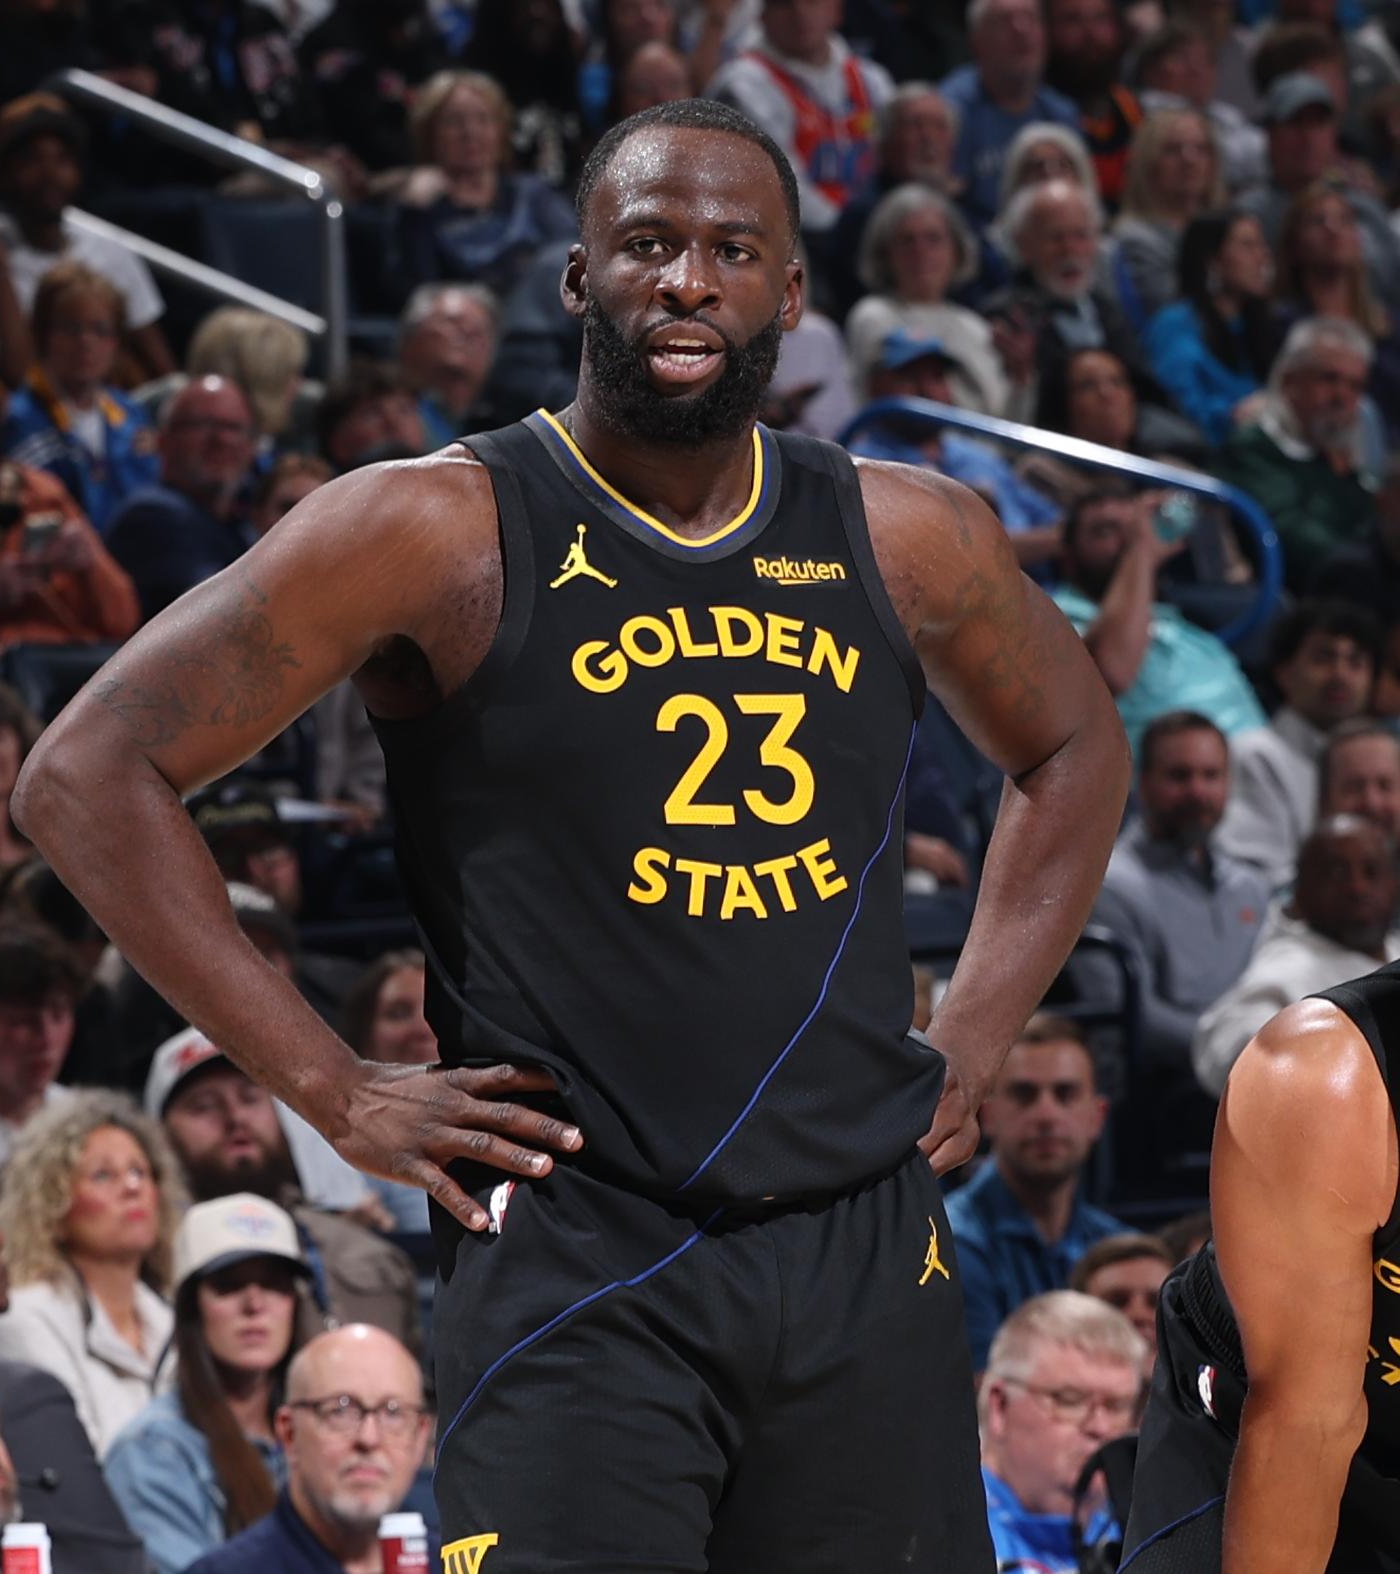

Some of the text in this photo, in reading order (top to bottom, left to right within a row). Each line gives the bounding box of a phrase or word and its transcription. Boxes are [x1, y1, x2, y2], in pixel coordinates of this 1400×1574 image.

[753, 555, 846, 586] Rakuten
[571, 606, 861, 694] GOLDEN
[655, 692, 816, 826] 23
[627, 837, 849, 920] STATE
